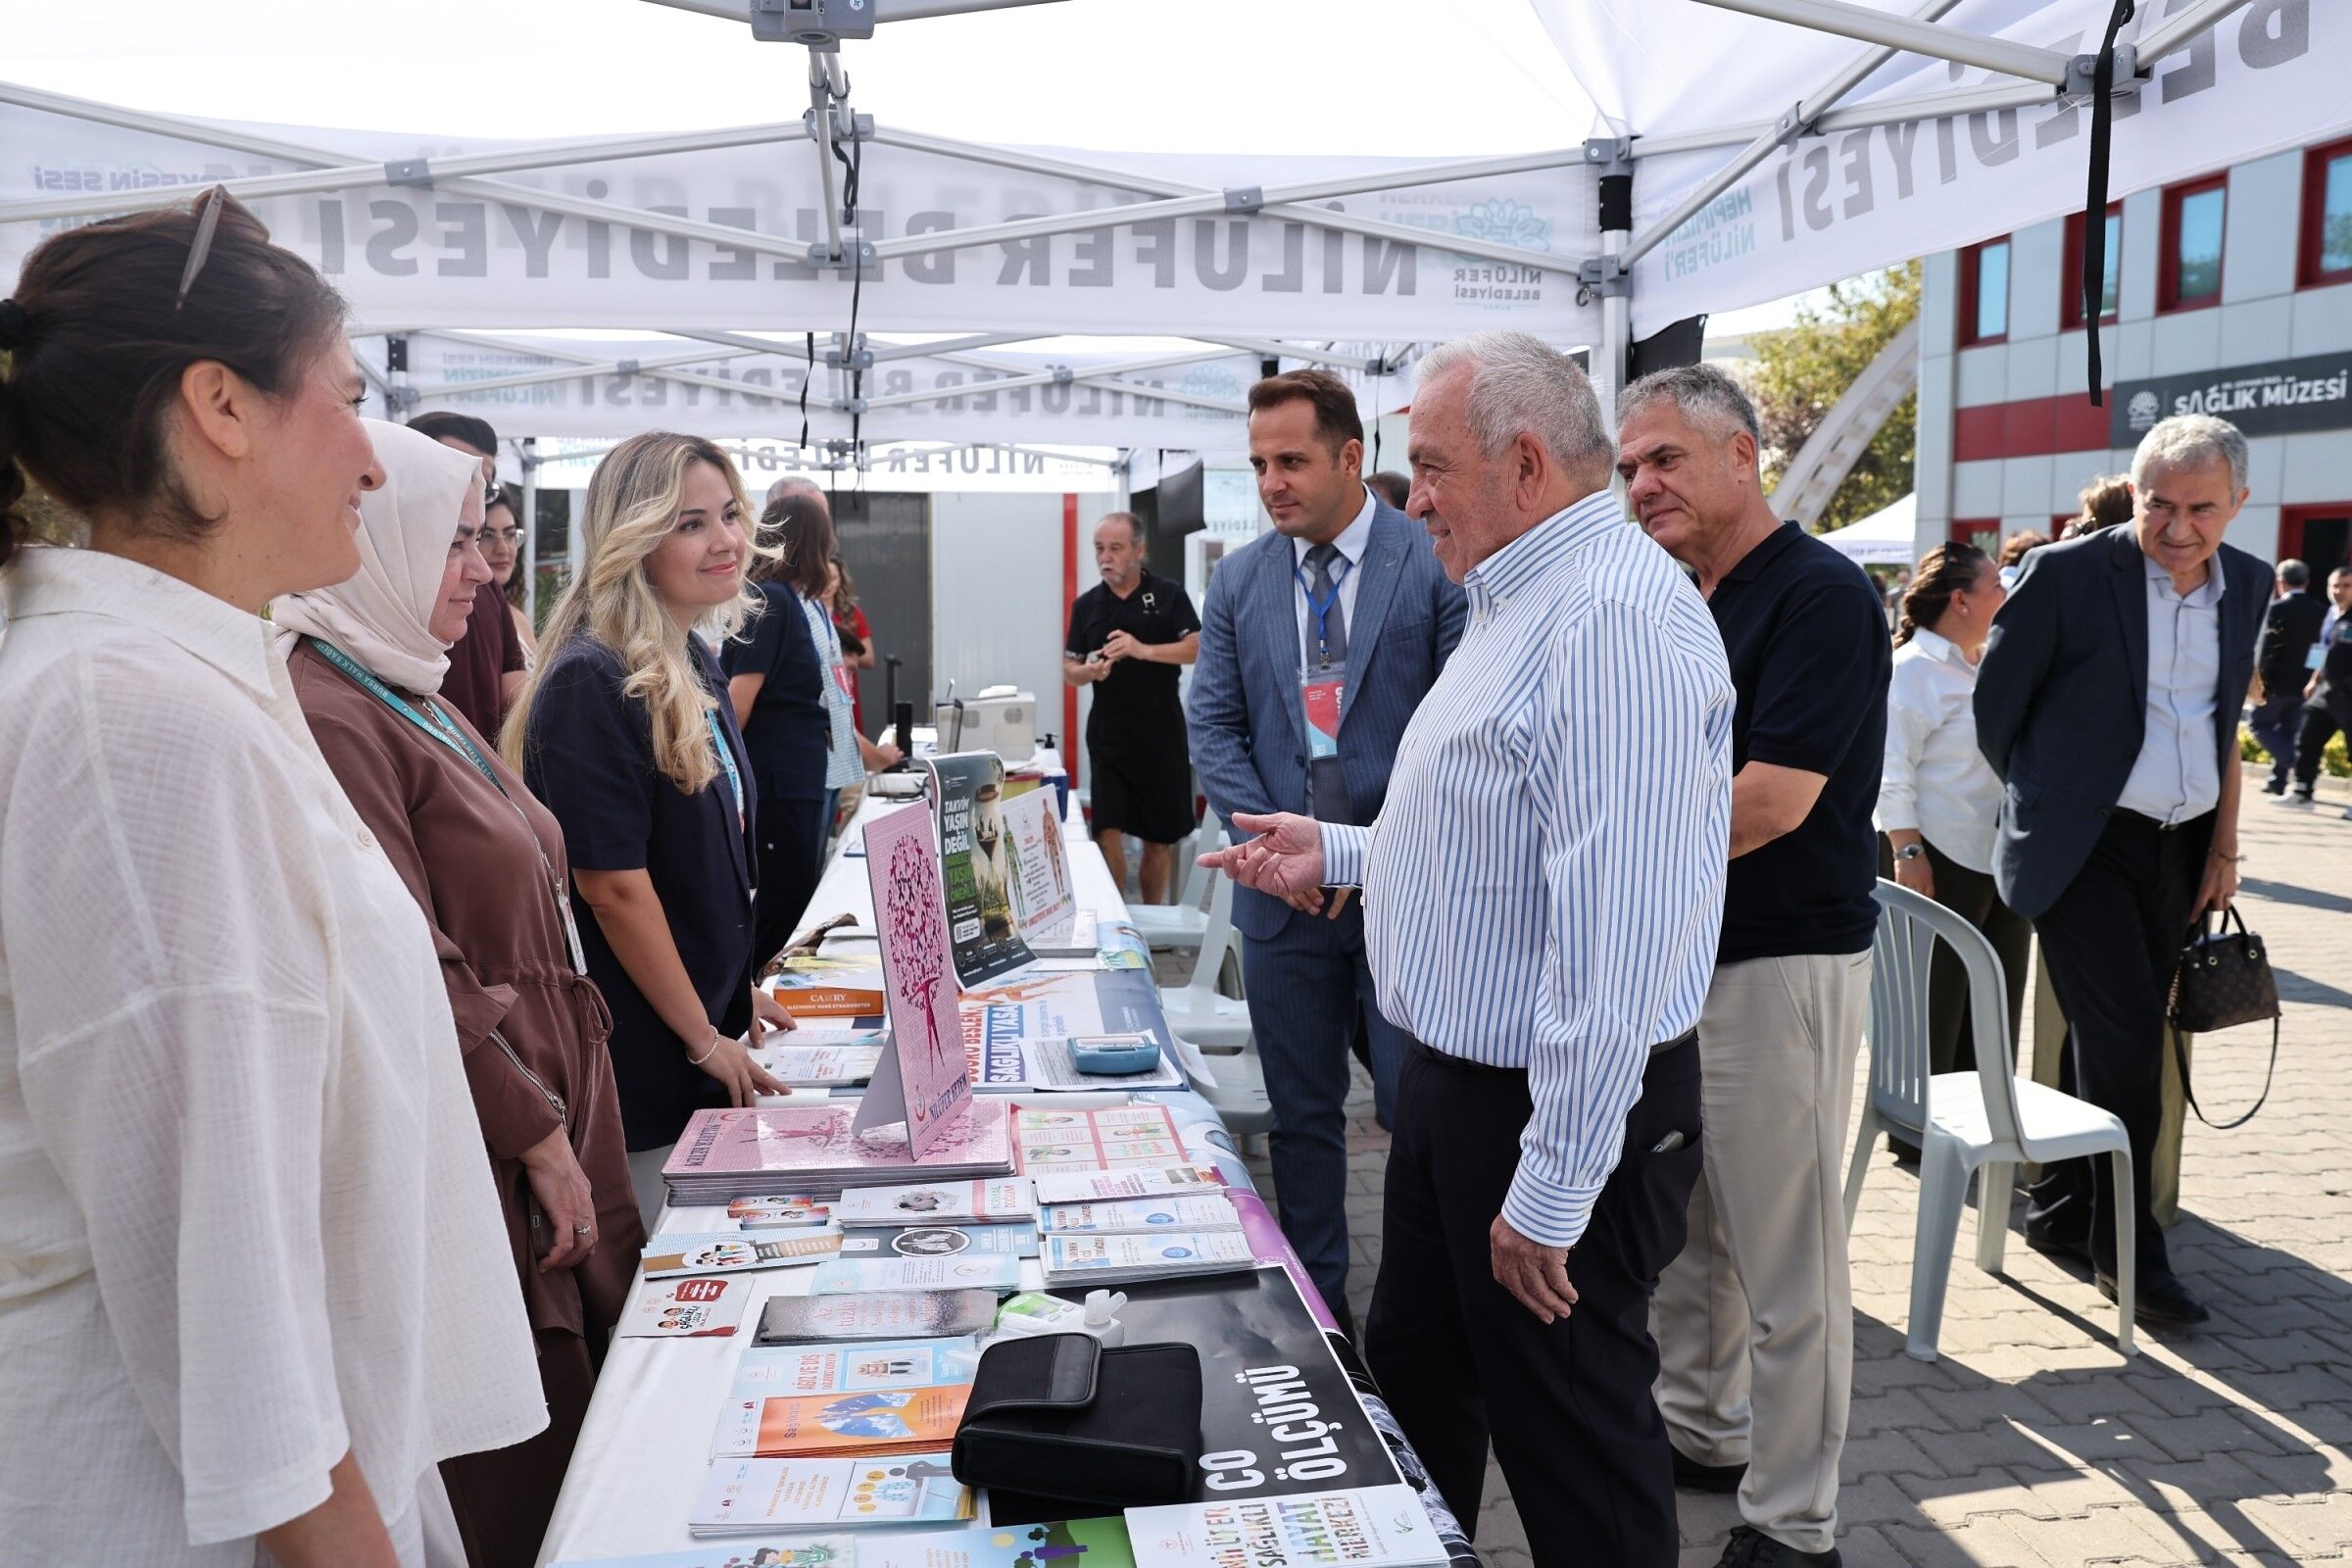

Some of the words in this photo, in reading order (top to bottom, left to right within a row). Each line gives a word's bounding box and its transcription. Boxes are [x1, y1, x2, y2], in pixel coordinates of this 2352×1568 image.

[945, 831, 970, 856] DEĞİL
[1234, 1365, 1348, 1481] ÖLÇÜMÜ
[1199, 1449, 1266, 1491] CO
[1238, 1503, 1288, 1568] SAĞLIKLI
[1276, 1497, 1339, 1564] HAYAT
[1314, 1496, 1374, 1560] MERKEZİ
